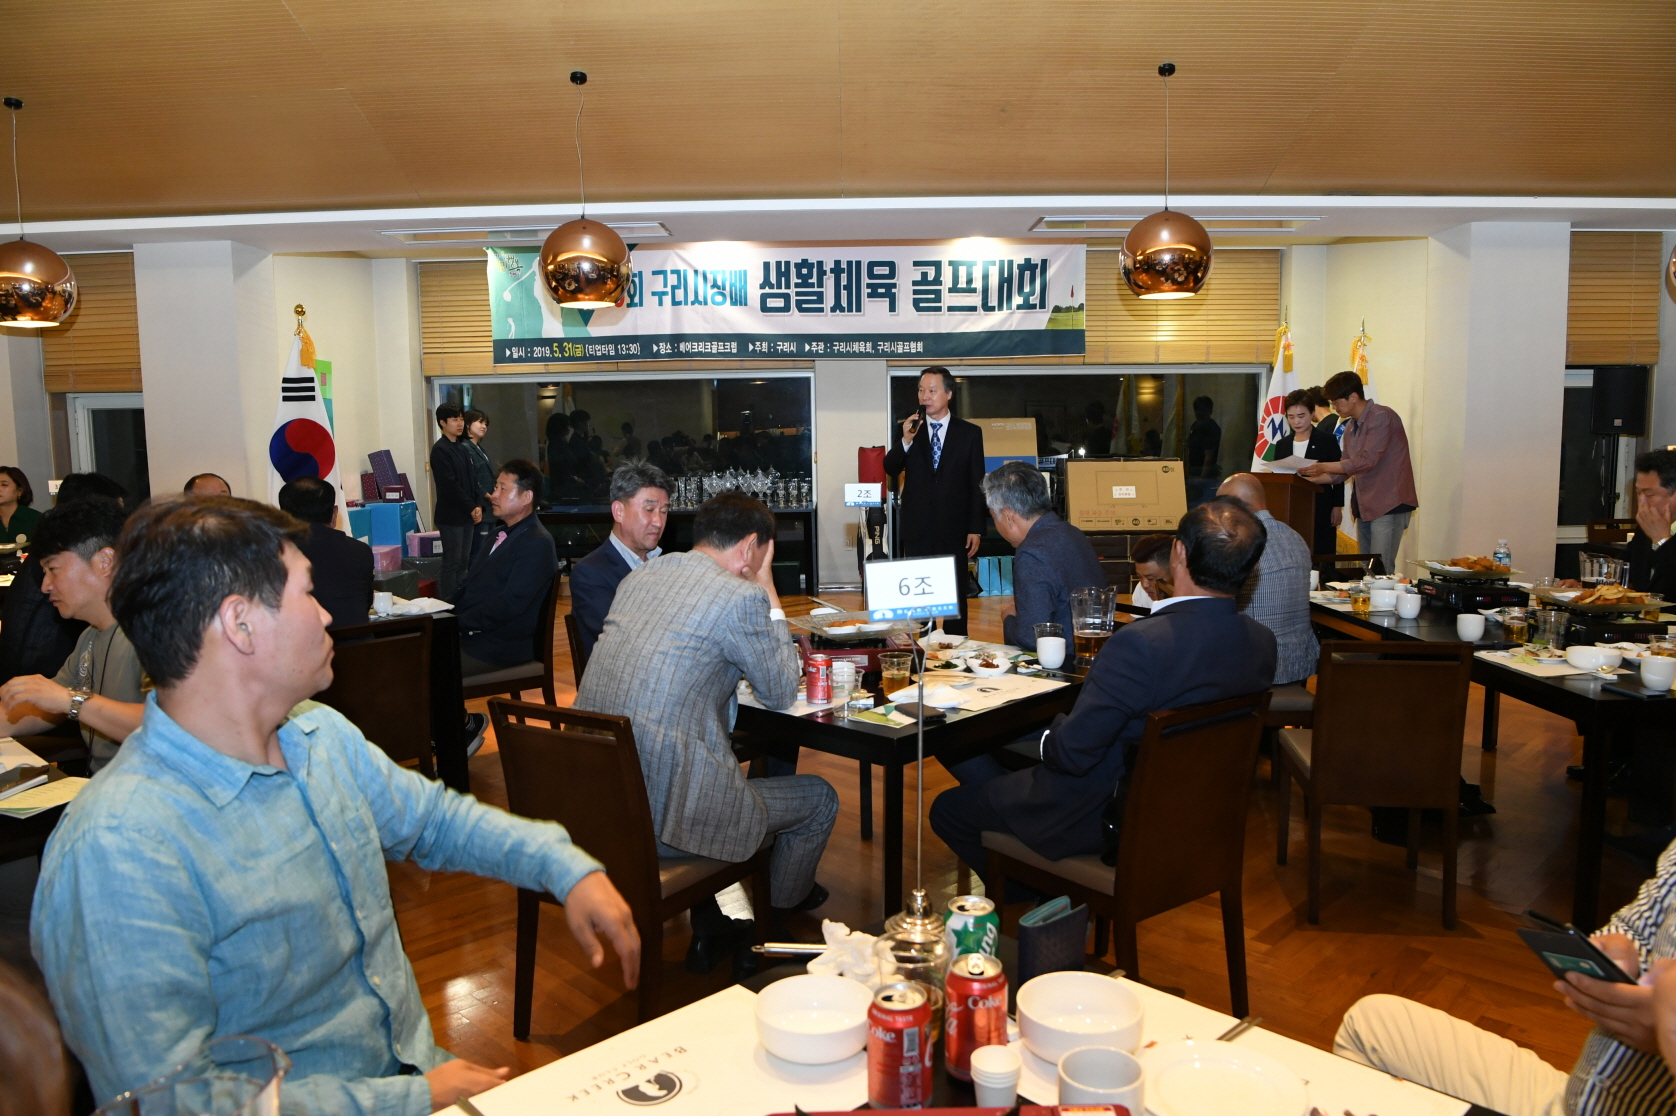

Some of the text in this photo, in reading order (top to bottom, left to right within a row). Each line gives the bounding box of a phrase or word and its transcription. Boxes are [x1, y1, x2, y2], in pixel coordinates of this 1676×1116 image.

[650, 268, 749, 308] 구리시장배
[758, 257, 898, 314] 생활체육
[911, 257, 1050, 314] 골프대회
[511, 346, 526, 358] 일시
[658, 342, 673, 354] 장소
[776, 341, 797, 353] 구리시
[810, 341, 825, 353] 주관
[877, 341, 924, 353] 구리시골프협회
[857, 489, 872, 499] 2조
[898, 576, 935, 597] 6조
[967, 994, 1002, 1011] Coke
[565, 1071, 632, 1102] CREEK
